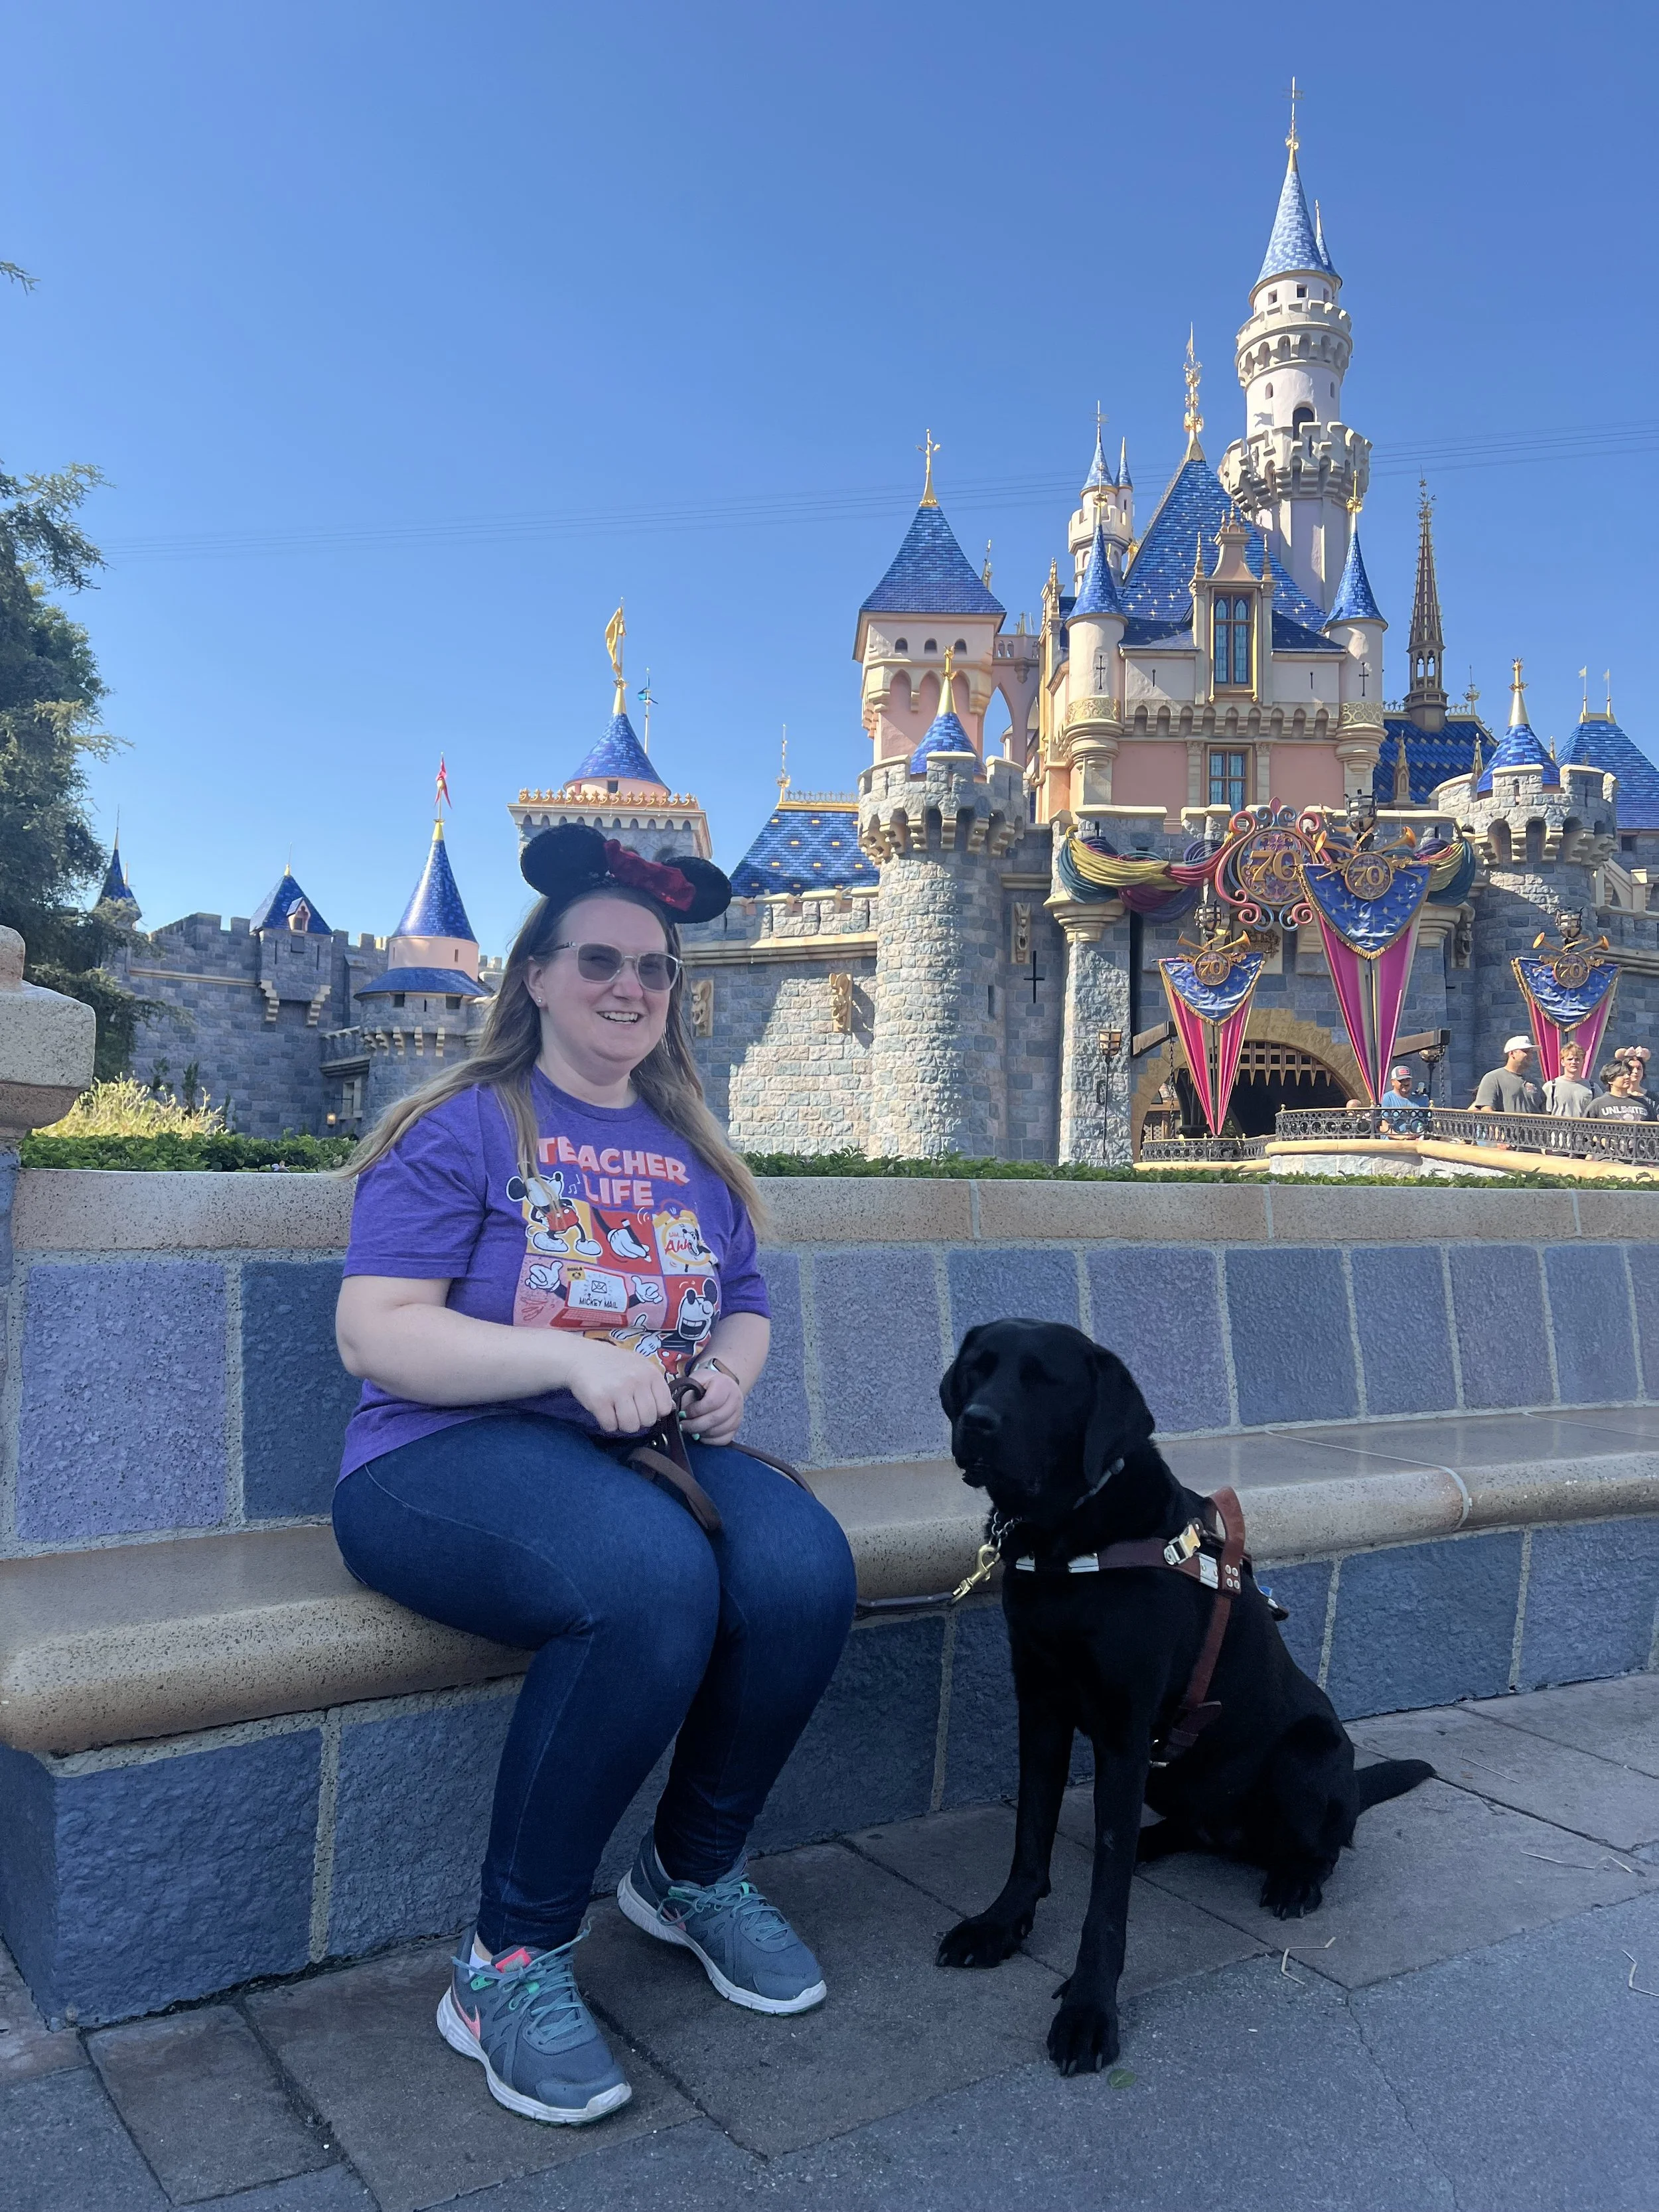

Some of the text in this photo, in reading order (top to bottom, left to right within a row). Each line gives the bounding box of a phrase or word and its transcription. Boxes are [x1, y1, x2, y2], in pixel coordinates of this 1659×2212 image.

[1249, 849, 1303, 882] 70
[1353, 865, 1385, 887] 70
[1198, 960, 1224, 976] 70
[1559, 963, 1583, 978] 70
[1601, 1106, 1648, 1116] UNLIMITED
[538, 1136, 690, 1185] TEACHER
[582, 1173, 654, 1208] LIFE
[579, 1297, 618, 1309] MICKEY MAIL
